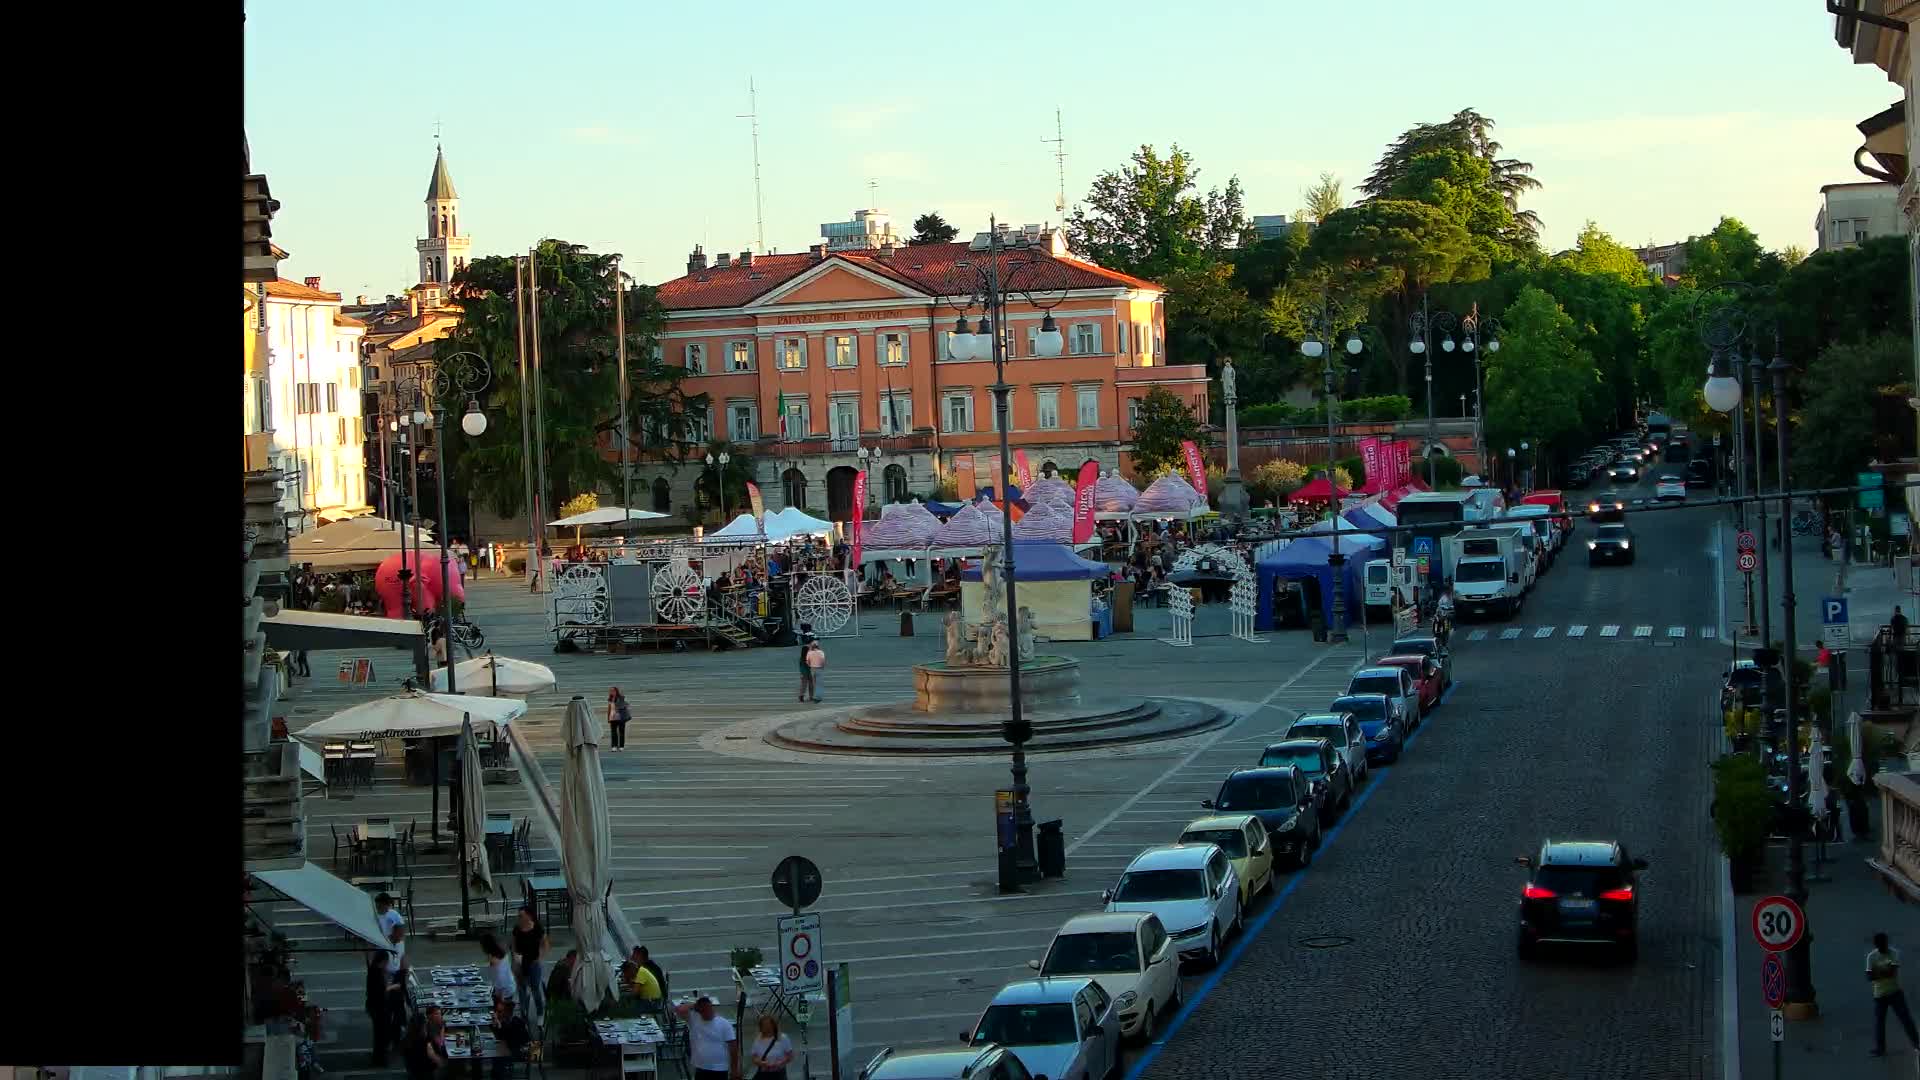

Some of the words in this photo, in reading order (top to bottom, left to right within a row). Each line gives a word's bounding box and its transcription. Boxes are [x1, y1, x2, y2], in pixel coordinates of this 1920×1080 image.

[831, 312, 848, 321] DEL
[1742, 556, 1753, 566] 20
[1828, 601, 1842, 621] P
[1762, 911, 1792, 937] 30
